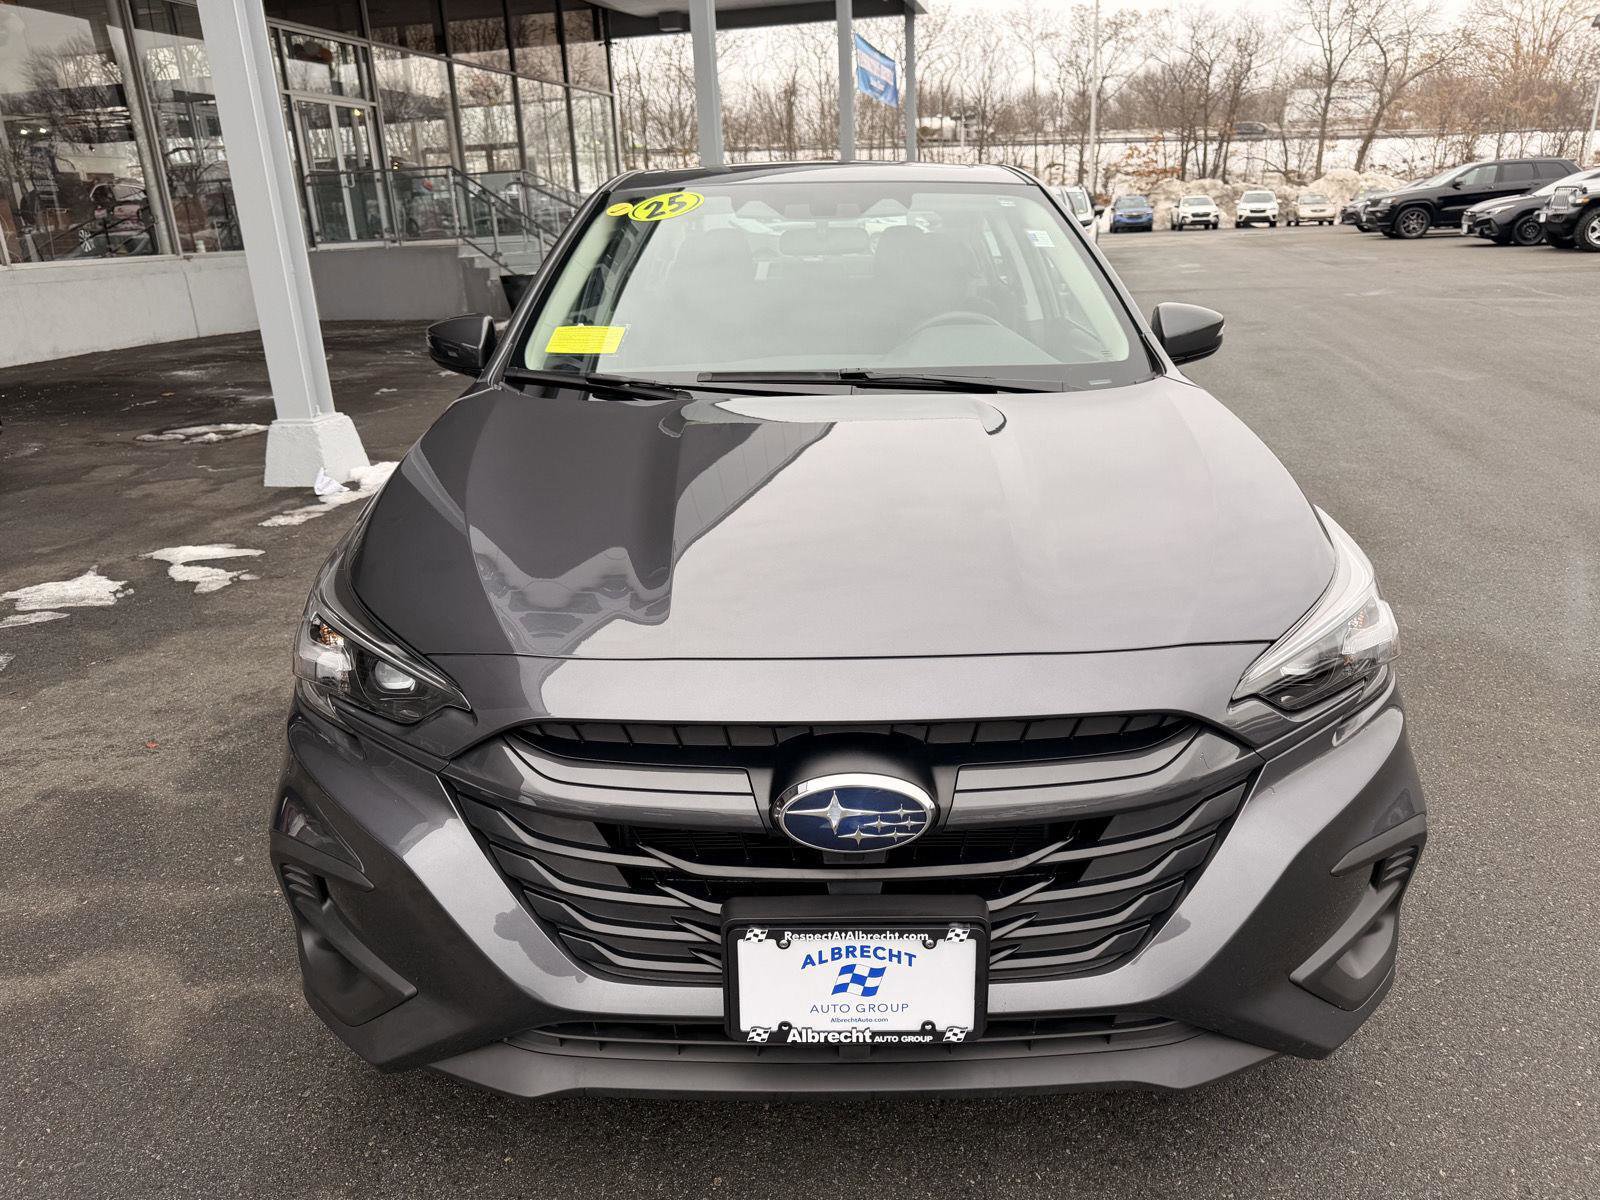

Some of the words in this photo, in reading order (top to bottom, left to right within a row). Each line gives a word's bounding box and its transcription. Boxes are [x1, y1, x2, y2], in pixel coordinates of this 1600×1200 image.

[643, 194, 687, 219] 25
[784, 931, 929, 942] RespectAtAlbrecht.com
[802, 945, 917, 969] ALBRECHT
[810, 1003, 851, 1014] AUTO
[855, 1003, 909, 1013] GROUP
[786, 1027, 873, 1043] Albrecht
[873, 1035, 899, 1043] AUTO
[900, 1035, 934, 1043] GROUP
